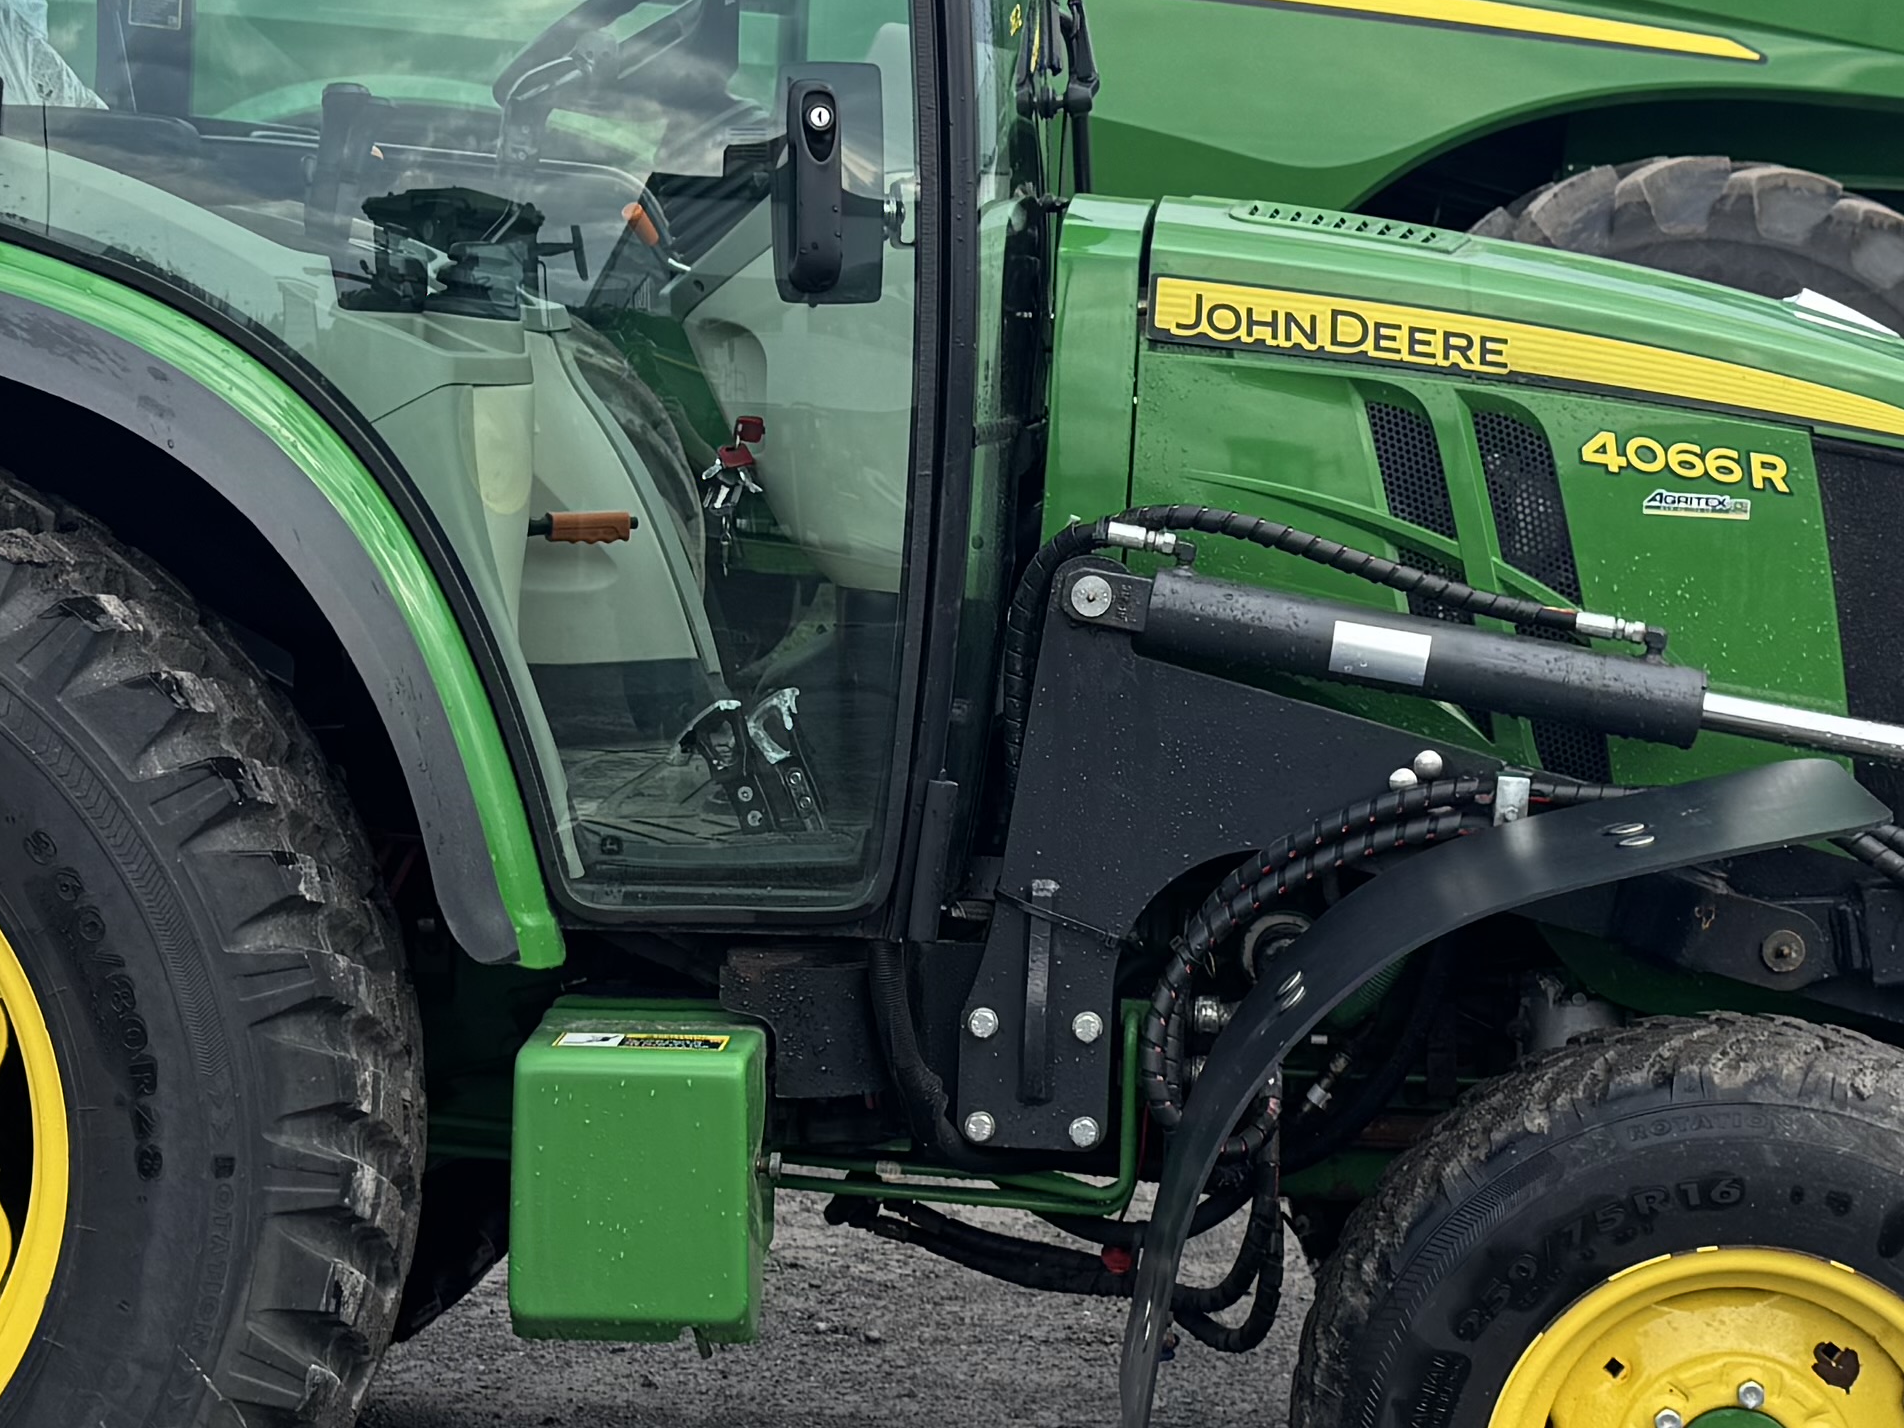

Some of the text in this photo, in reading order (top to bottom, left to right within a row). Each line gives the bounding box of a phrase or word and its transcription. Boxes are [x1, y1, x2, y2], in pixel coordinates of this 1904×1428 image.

[1176, 293, 1510, 371] JOHN DEERE
[1647, 492, 1728, 509] AGRITEX
